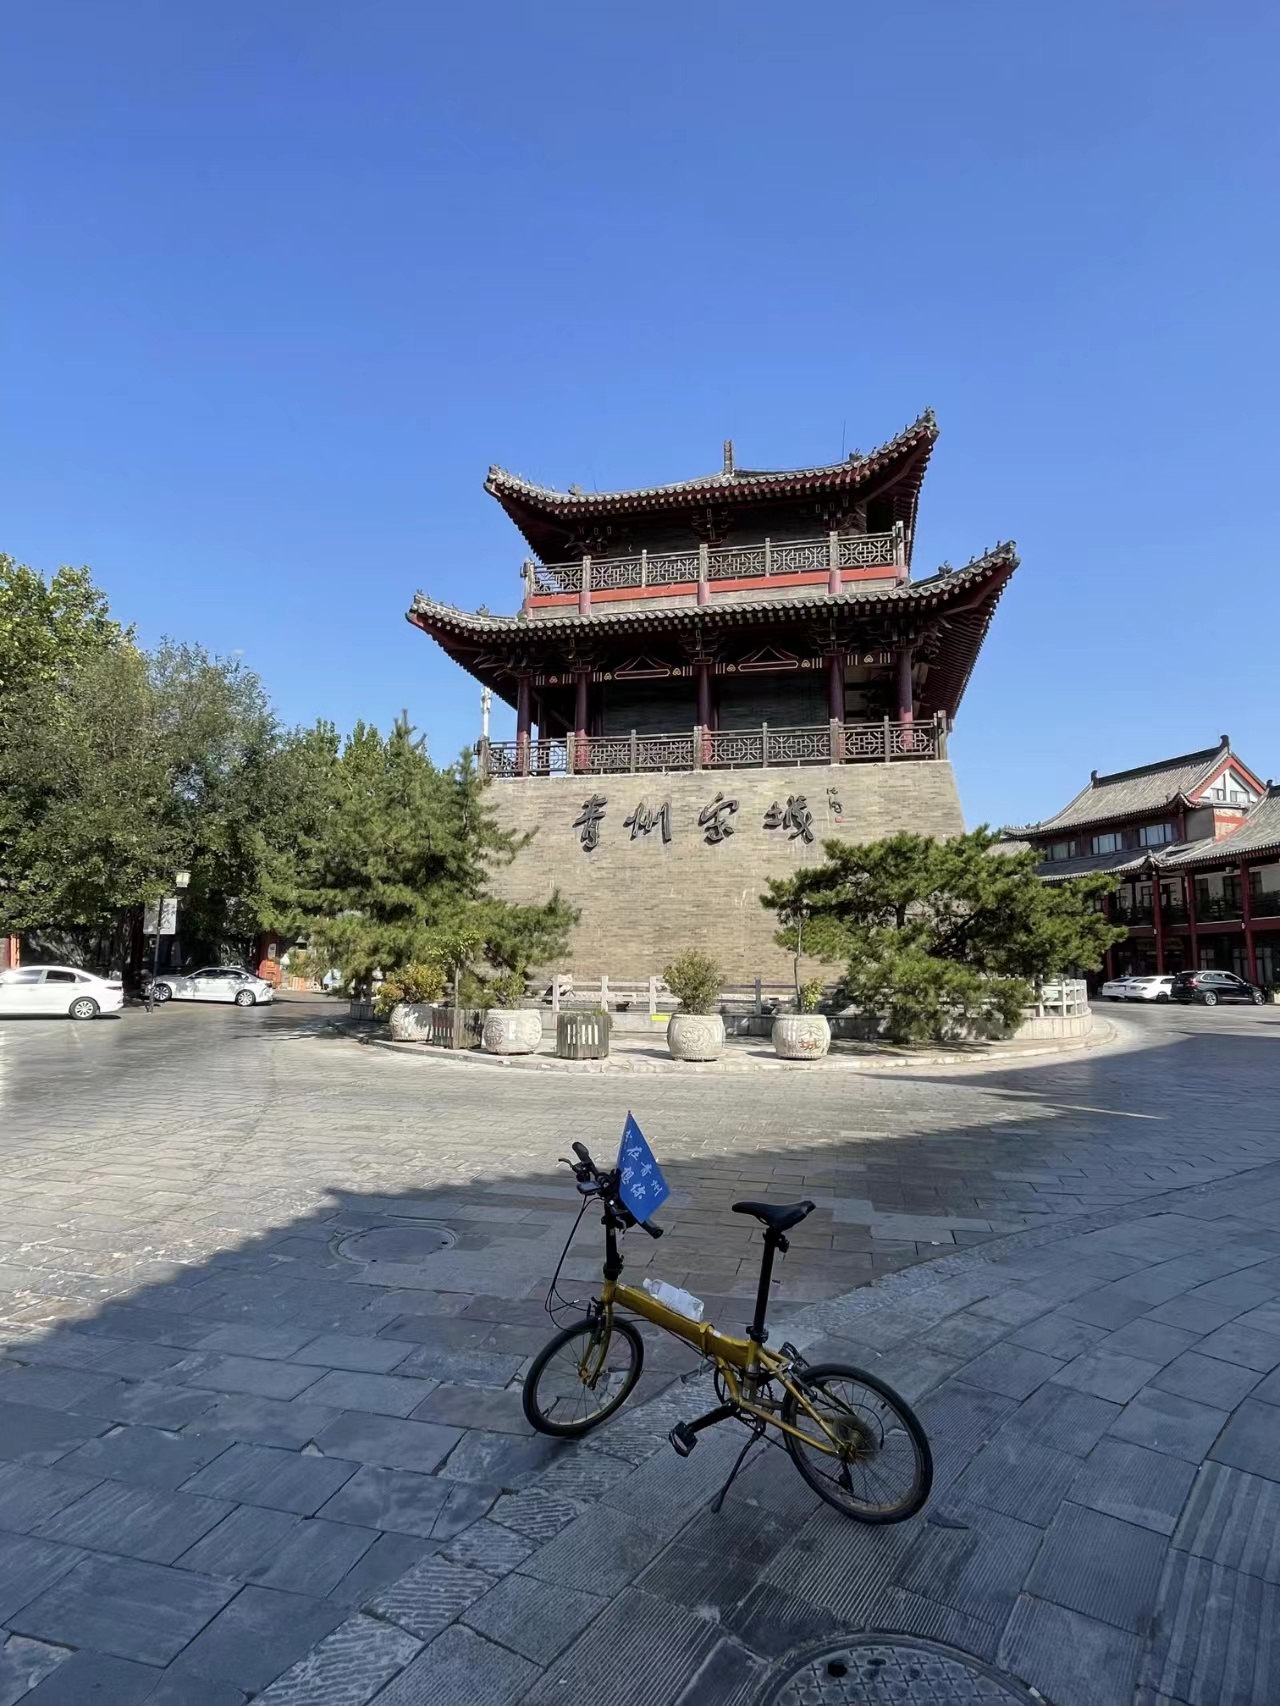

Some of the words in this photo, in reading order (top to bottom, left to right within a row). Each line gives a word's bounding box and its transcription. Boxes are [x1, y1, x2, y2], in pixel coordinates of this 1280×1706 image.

[572, 792, 814, 852] 青州宋城
[621, 1157, 646, 1199] 想你
